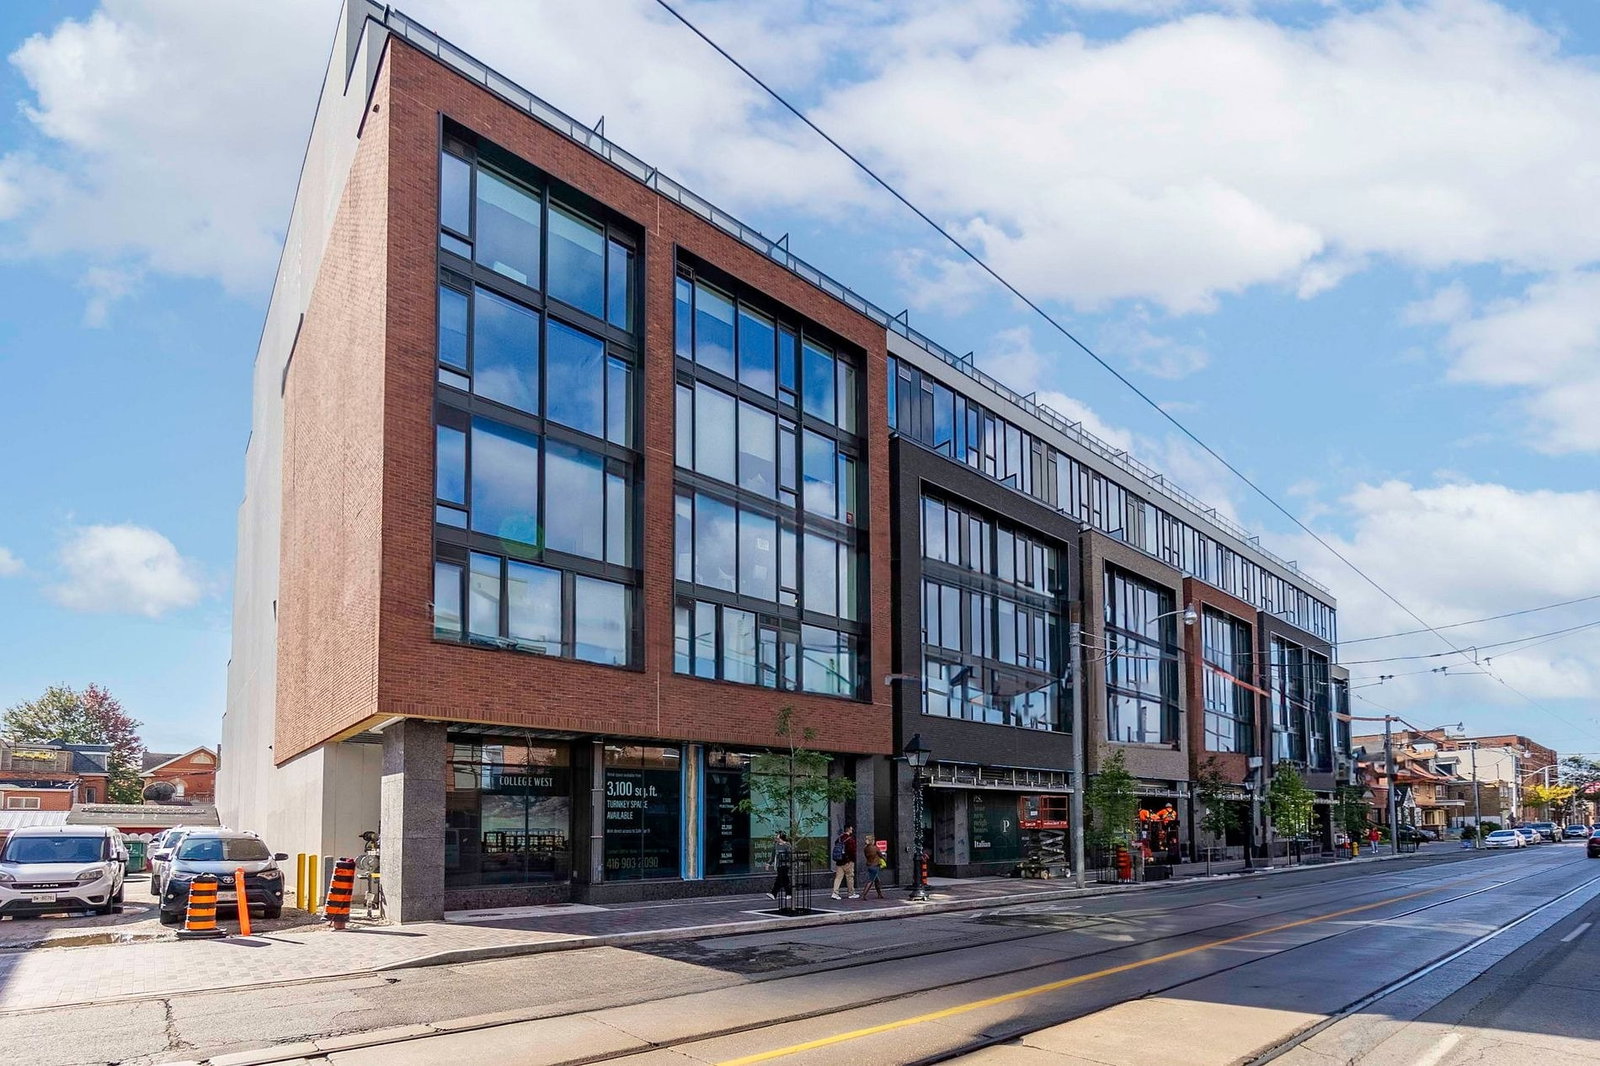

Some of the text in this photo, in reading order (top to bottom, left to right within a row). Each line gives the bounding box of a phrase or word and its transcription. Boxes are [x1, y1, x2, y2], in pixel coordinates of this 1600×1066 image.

[499, 775, 553, 788] COLLEGE WEST
[606, 781, 633, 797] 3,100
[648, 785, 658, 798] ft.
[606, 799, 630, 809] TURNKEY
[606, 811, 634, 820] AVAILABLE
[974, 840, 991, 848] Italian
